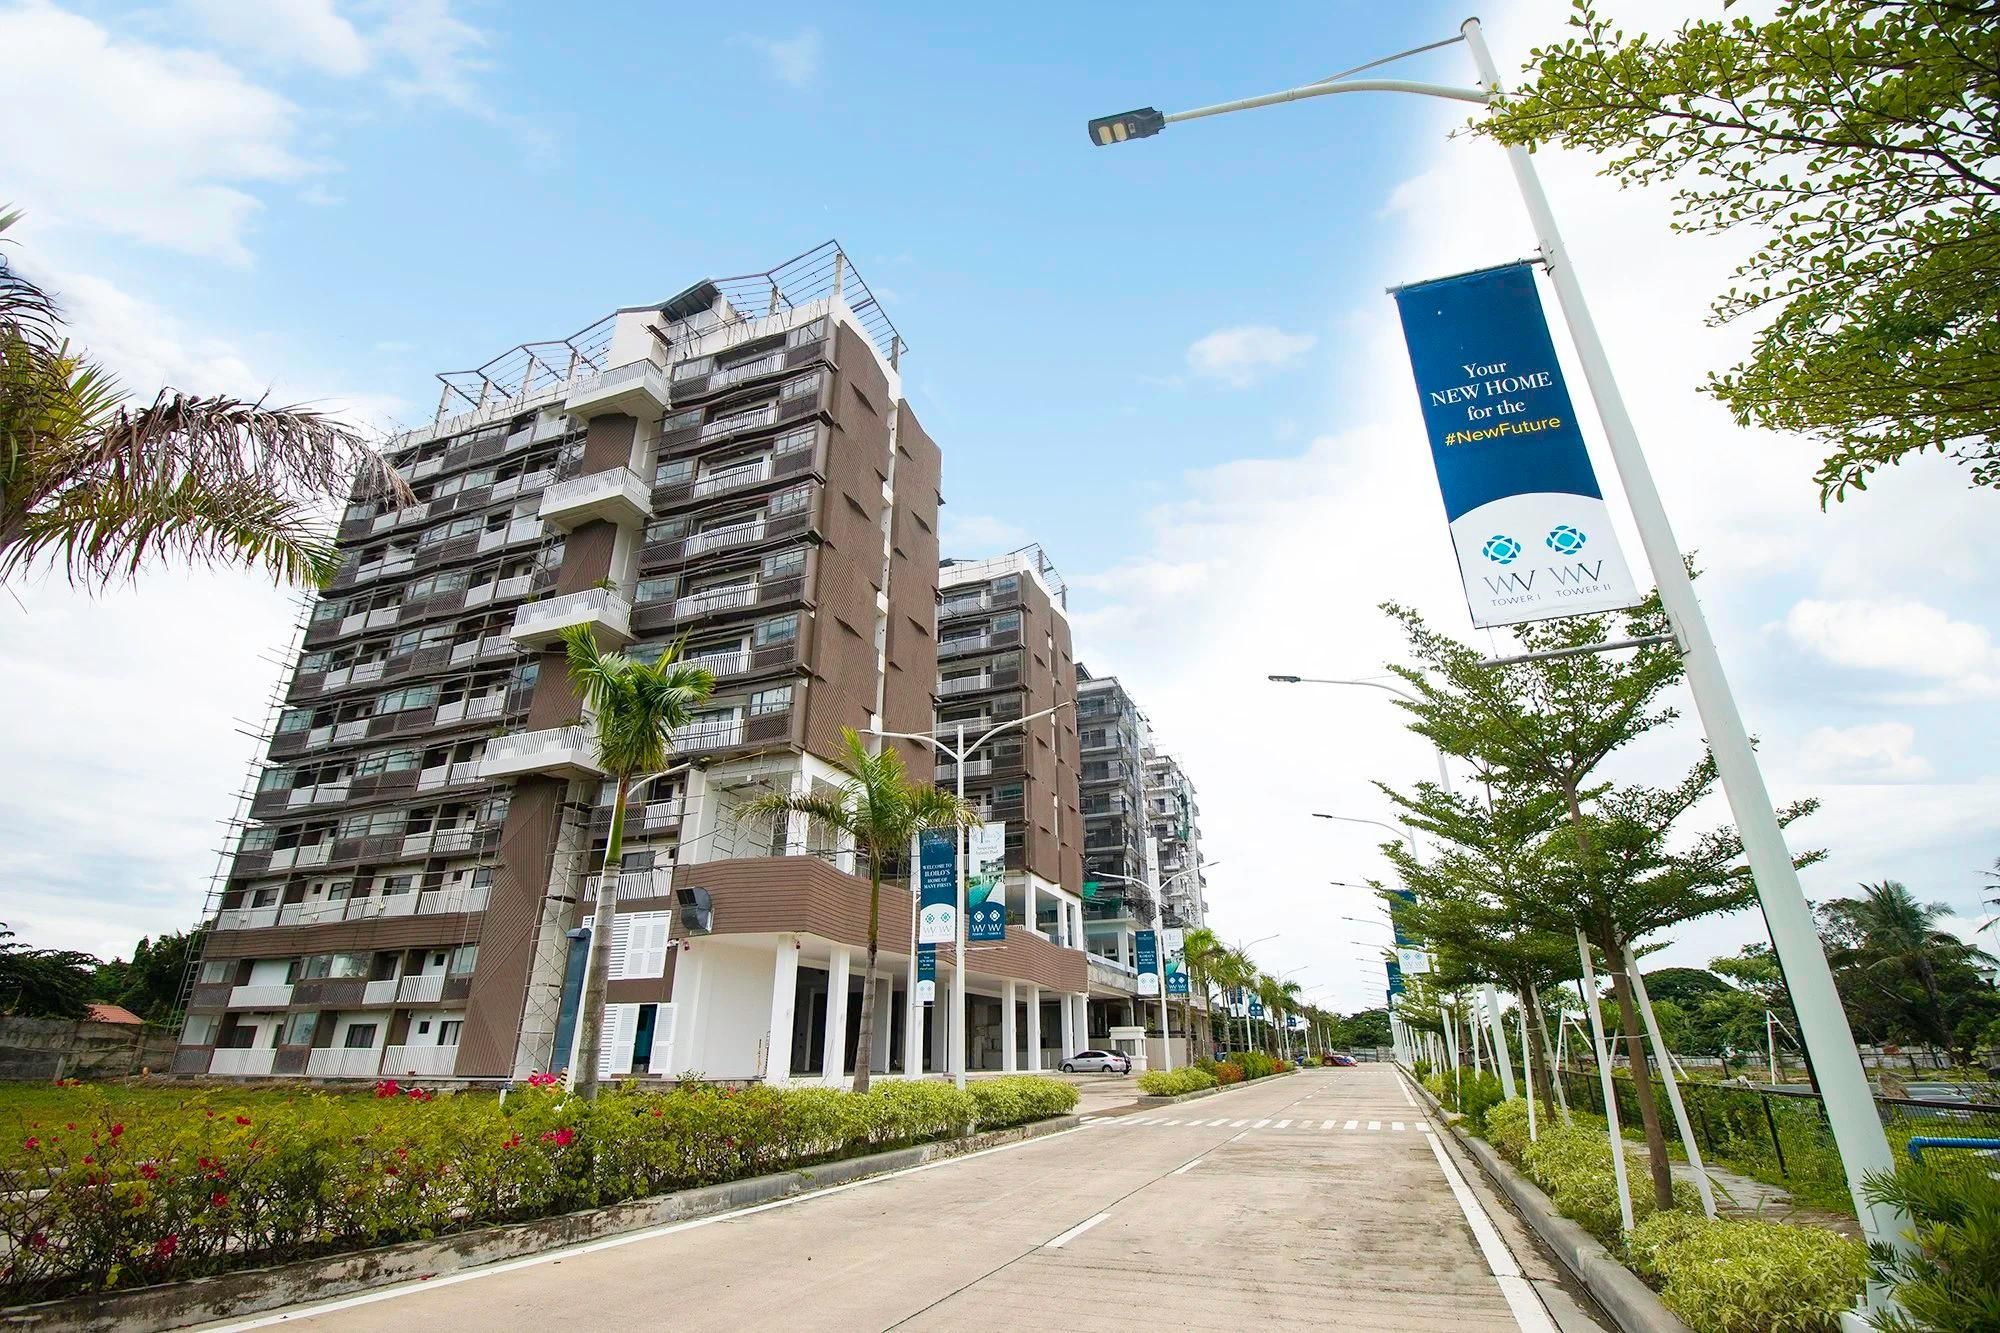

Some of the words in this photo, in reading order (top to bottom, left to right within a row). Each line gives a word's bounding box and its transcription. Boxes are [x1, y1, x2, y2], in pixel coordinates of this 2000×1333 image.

[1462, 362, 1506, 379] Your
[1430, 383, 1480, 407] NEW
[1485, 371, 1553, 396] HOME
[1466, 406, 1493, 422] for
[1496, 399, 1527, 416] the
[1445, 417, 1560, 447] #NewFuture
[1491, 594, 1533, 607] TOWER
[1555, 584, 1600, 598] TOWER
